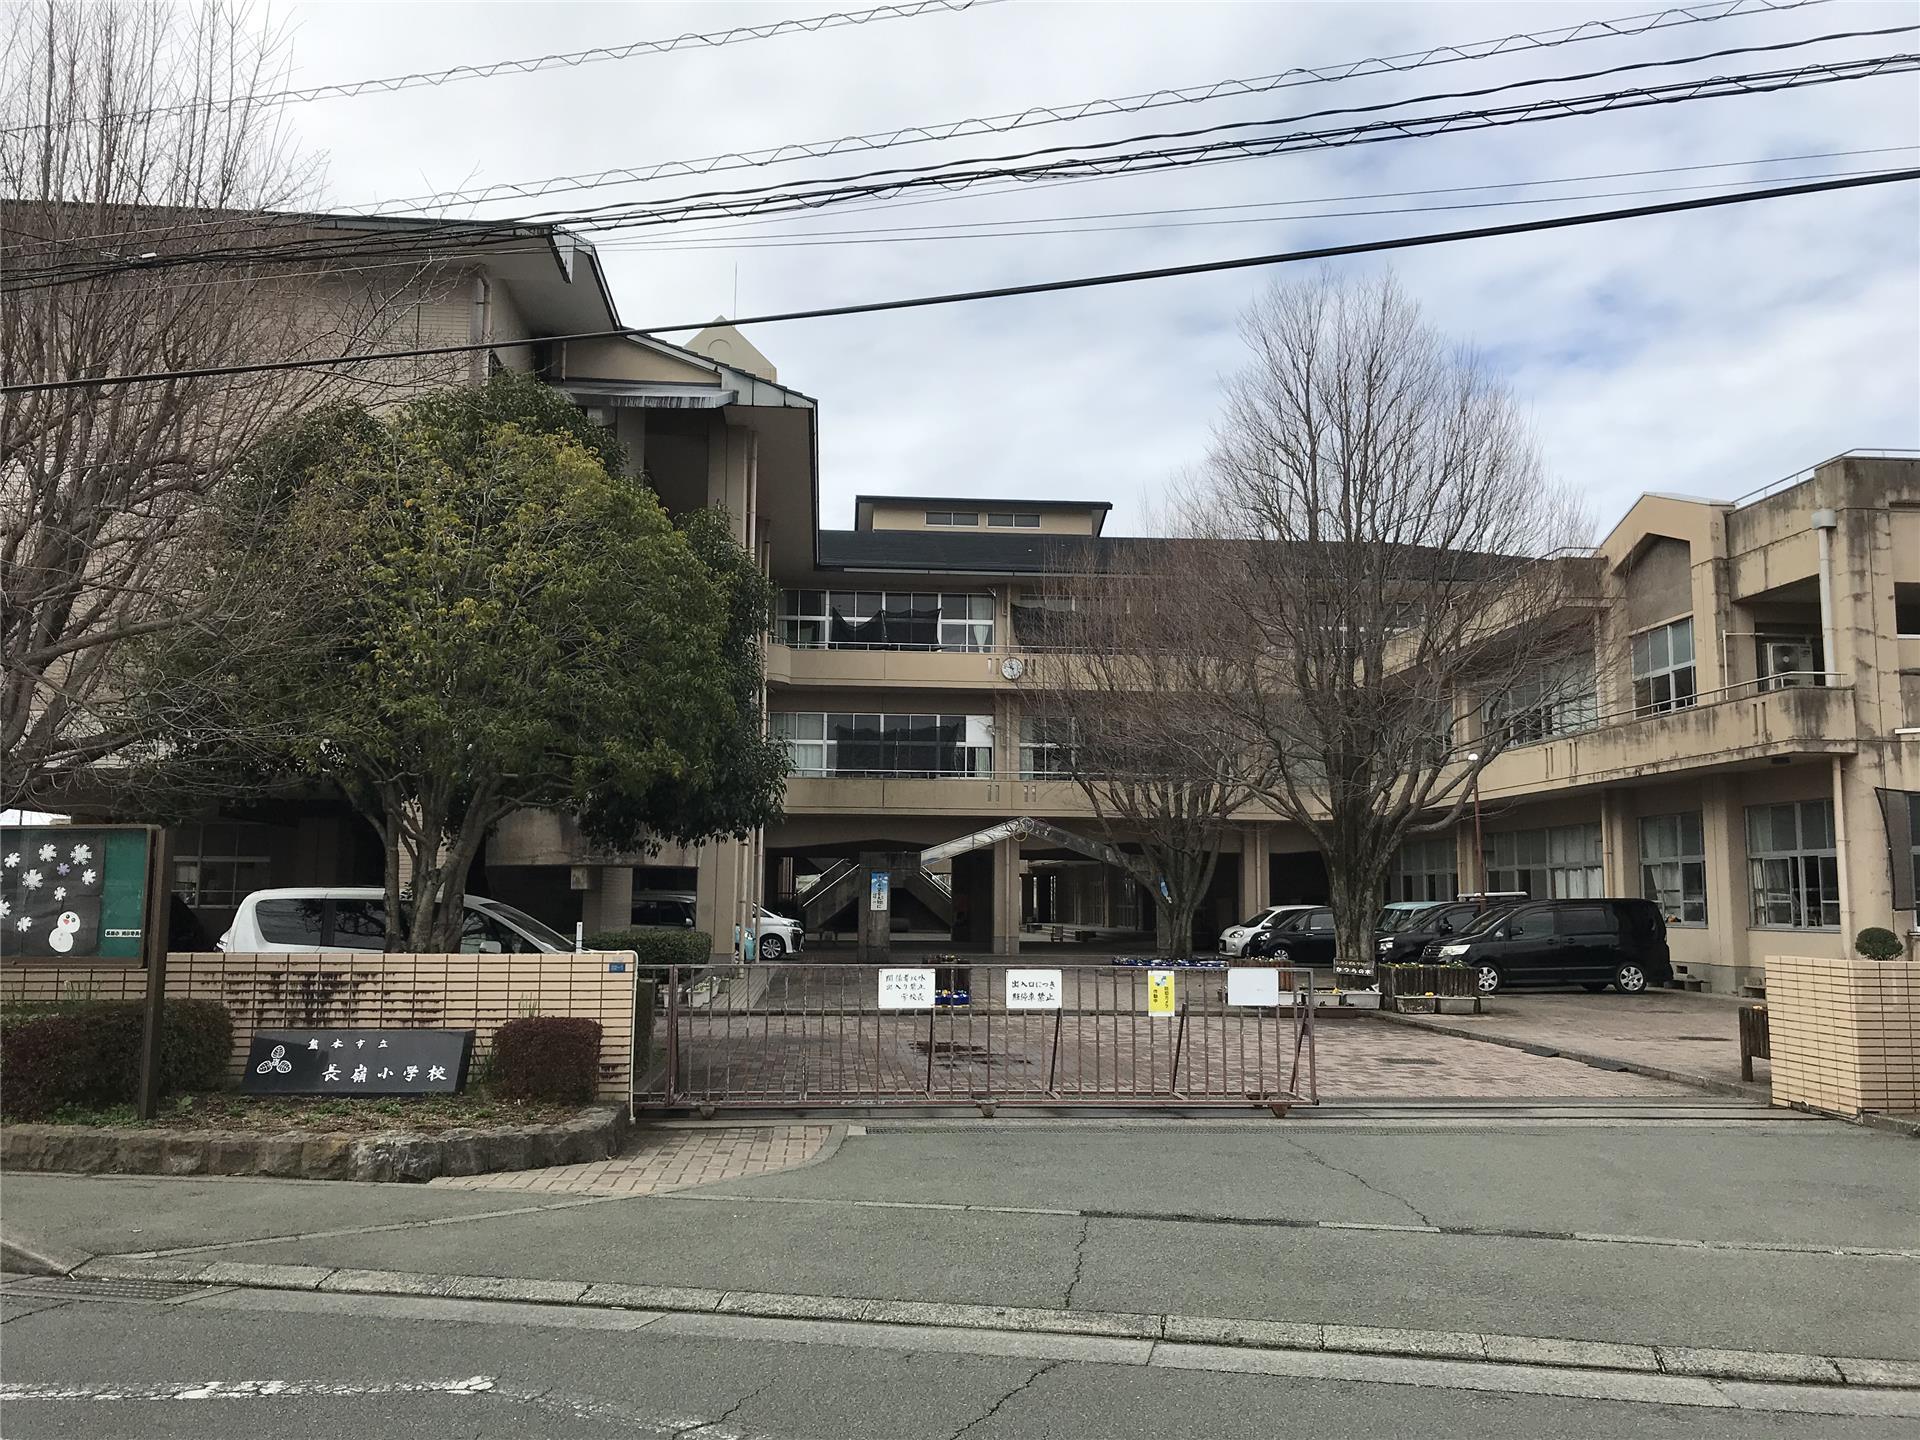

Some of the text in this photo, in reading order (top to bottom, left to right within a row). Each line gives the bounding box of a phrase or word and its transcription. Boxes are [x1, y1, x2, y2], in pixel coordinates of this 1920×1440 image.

[886, 974, 926, 982] 関係者以外
[1011, 980, 1055, 990] 出入口につき
[1012, 992, 1055, 1002] 駐停車禁止
[307, 1038, 389, 1050] 熊本市立
[321, 1063, 448, 1083] 長嶺小学校
